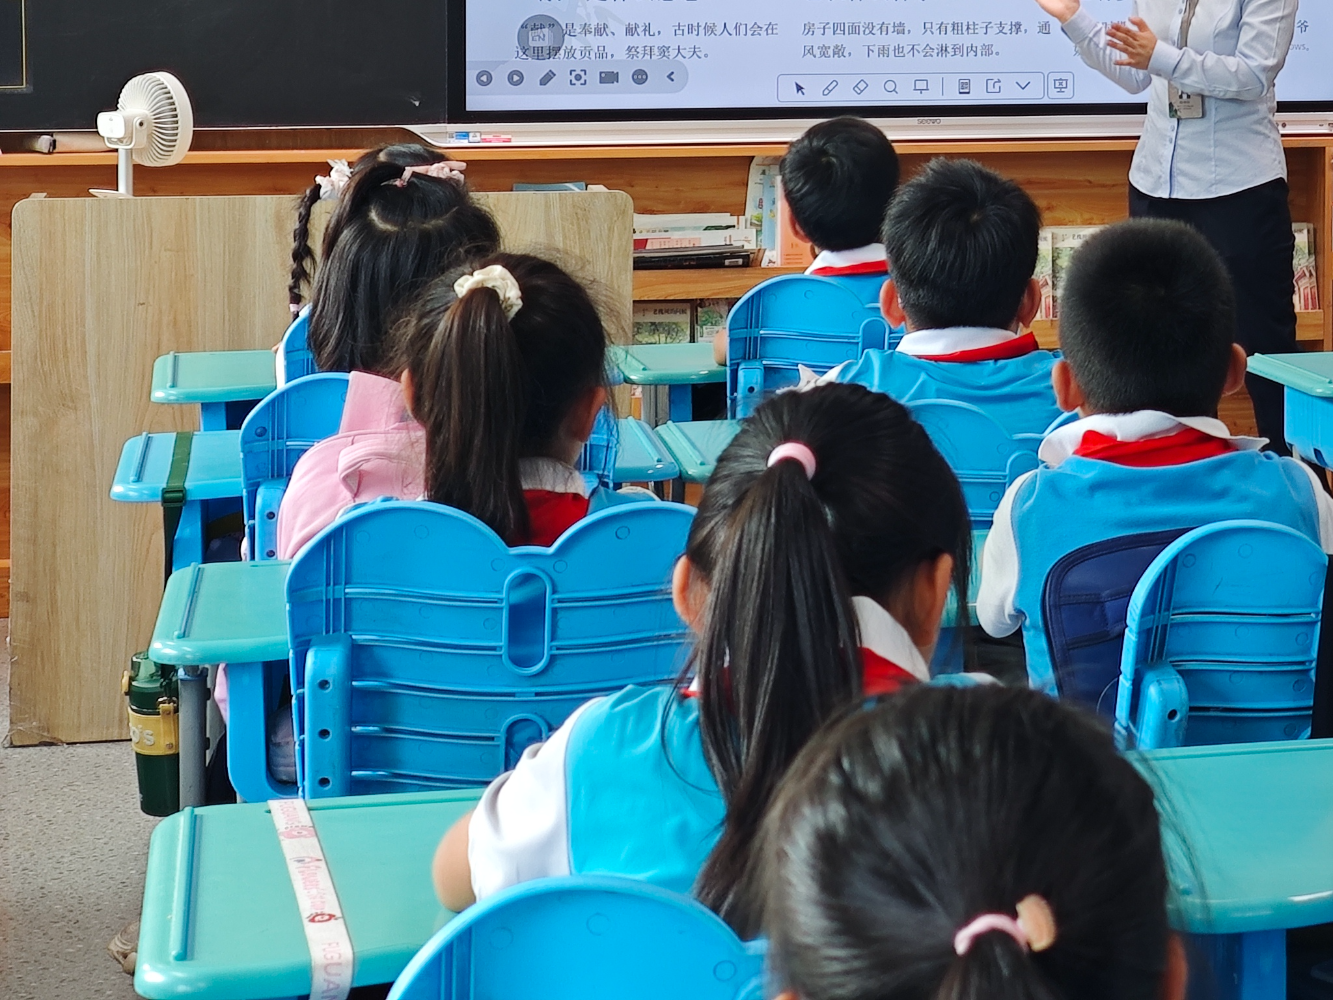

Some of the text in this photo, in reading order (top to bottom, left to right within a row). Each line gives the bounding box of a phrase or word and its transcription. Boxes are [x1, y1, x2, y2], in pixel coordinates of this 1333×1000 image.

[801, 20, 1052, 37] 房子四面没有墙，只有粗柱子支撑，通
[514, 44, 710, 60] 这里摆放贡品，祭拜窦大夫。
[801, 43, 1002, 60] 风宽敞，下雨也不会淋到内部。
